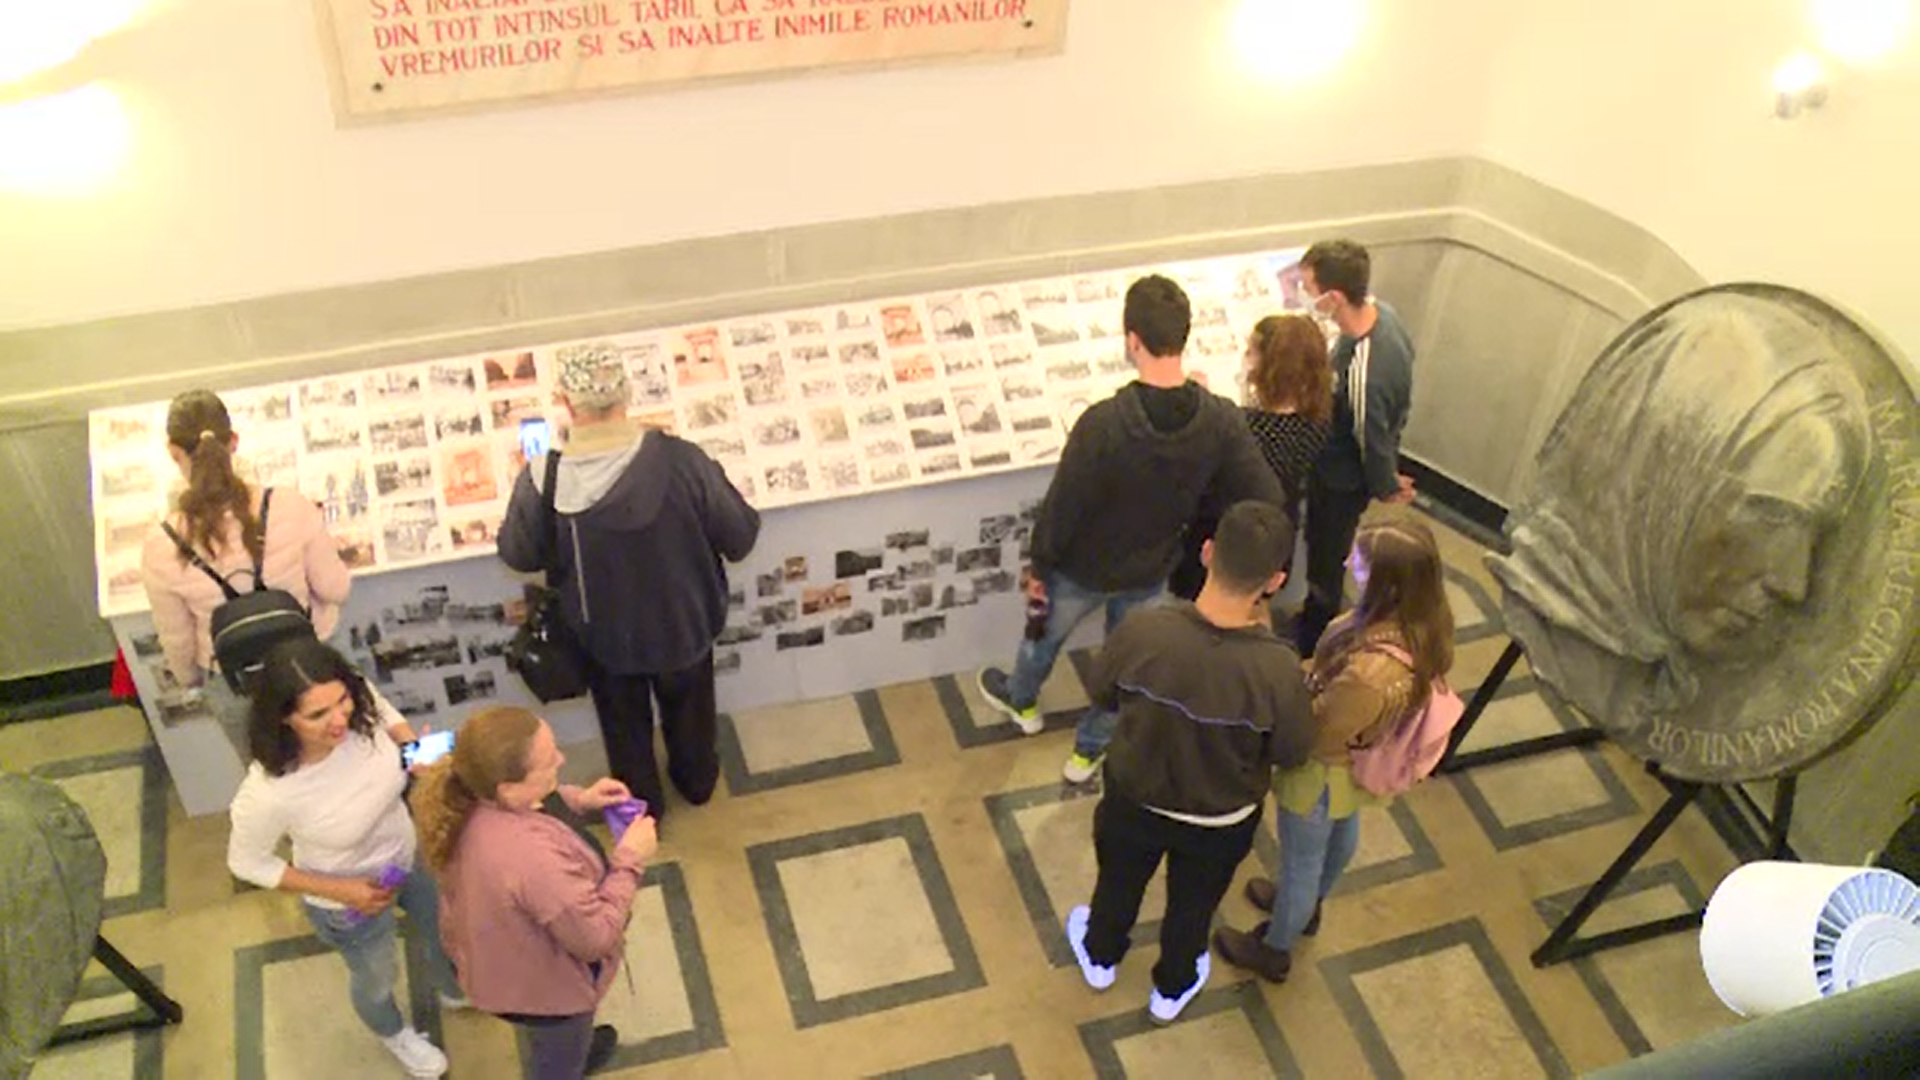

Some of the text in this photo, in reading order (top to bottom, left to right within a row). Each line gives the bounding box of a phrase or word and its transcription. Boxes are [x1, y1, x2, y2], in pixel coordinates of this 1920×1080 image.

[373, 23, 419, 50] DIN
[427, 16, 481, 43] TOT
[494, 3, 620, 38] INTINSUL
[380, 38, 562, 77] VREMURILOR
[618, 28, 655, 53] SA
[668, 18, 765, 48] INALTE
[775, 10, 871, 38] INIMILE
[883, 0, 1026, 29] ROMANILOR
[1832, 549, 1918, 696] REGINA
[1648, 688, 1842, 766] ROMANILOR
